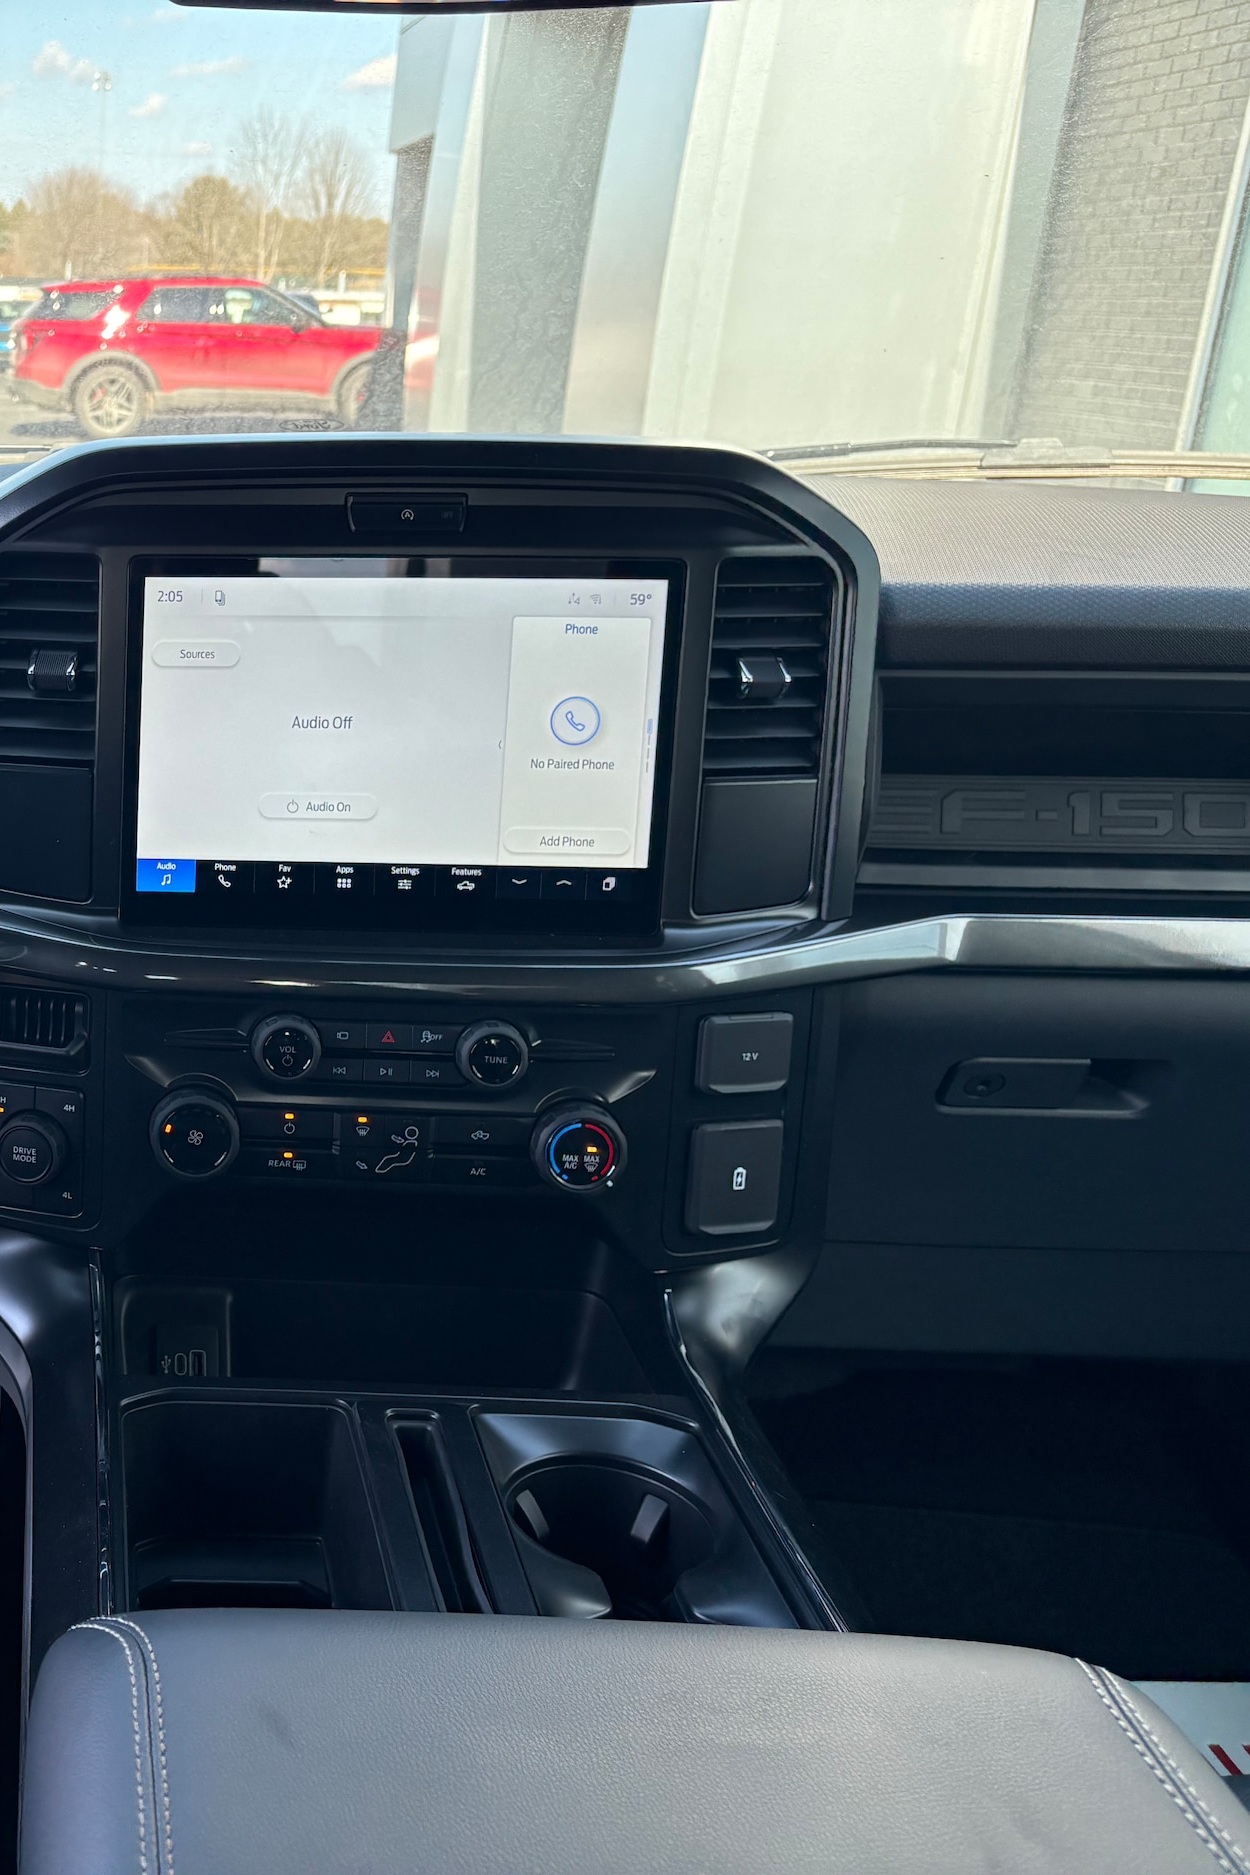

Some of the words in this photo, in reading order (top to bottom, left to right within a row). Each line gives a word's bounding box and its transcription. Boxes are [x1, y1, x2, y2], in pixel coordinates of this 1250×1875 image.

[157, 590, 183, 603] 2:05
[630, 593, 652, 606] 59°
[564, 623, 599, 635] Phone
[179, 648, 215, 660] Sources
[291, 715, 330, 730] Audio
[332, 715, 354, 730] Off
[530, 758, 545, 769] No
[547, 758, 580, 770] Paired
[582, 759, 615, 770] Phone
[305, 801, 335, 813] Audio
[336, 802, 351, 813] On
[940, 788, 1250, 839] F-150
[539, 835, 560, 847] Add
[562, 836, 595, 848] Phone
[156, 862, 176, 871] Audio
[214, 862, 237, 872] Phone
[278, 863, 292, 873] Fav
[335, 865, 354, 875] Apps
[391, 866, 420, 877] Settings
[451, 867, 482, 877] Features
[279, 1046, 297, 1054] VOL
[484, 1055, 509, 1064] TUNE
[63, 1104, 75, 1113] 4H
[12, 1146, 37, 1156] DRIVE
[12, 1154, 37, 1163] MODE
[267, 1159, 291, 1168] REAR
[562, 1154, 579, 1163] MAX
[583, 1155, 600, 1163] MAX
[563, 1161, 578, 1170] A/C
[470, 1167, 487, 1176] A/C
[62, 1191, 73, 1200] 4L
